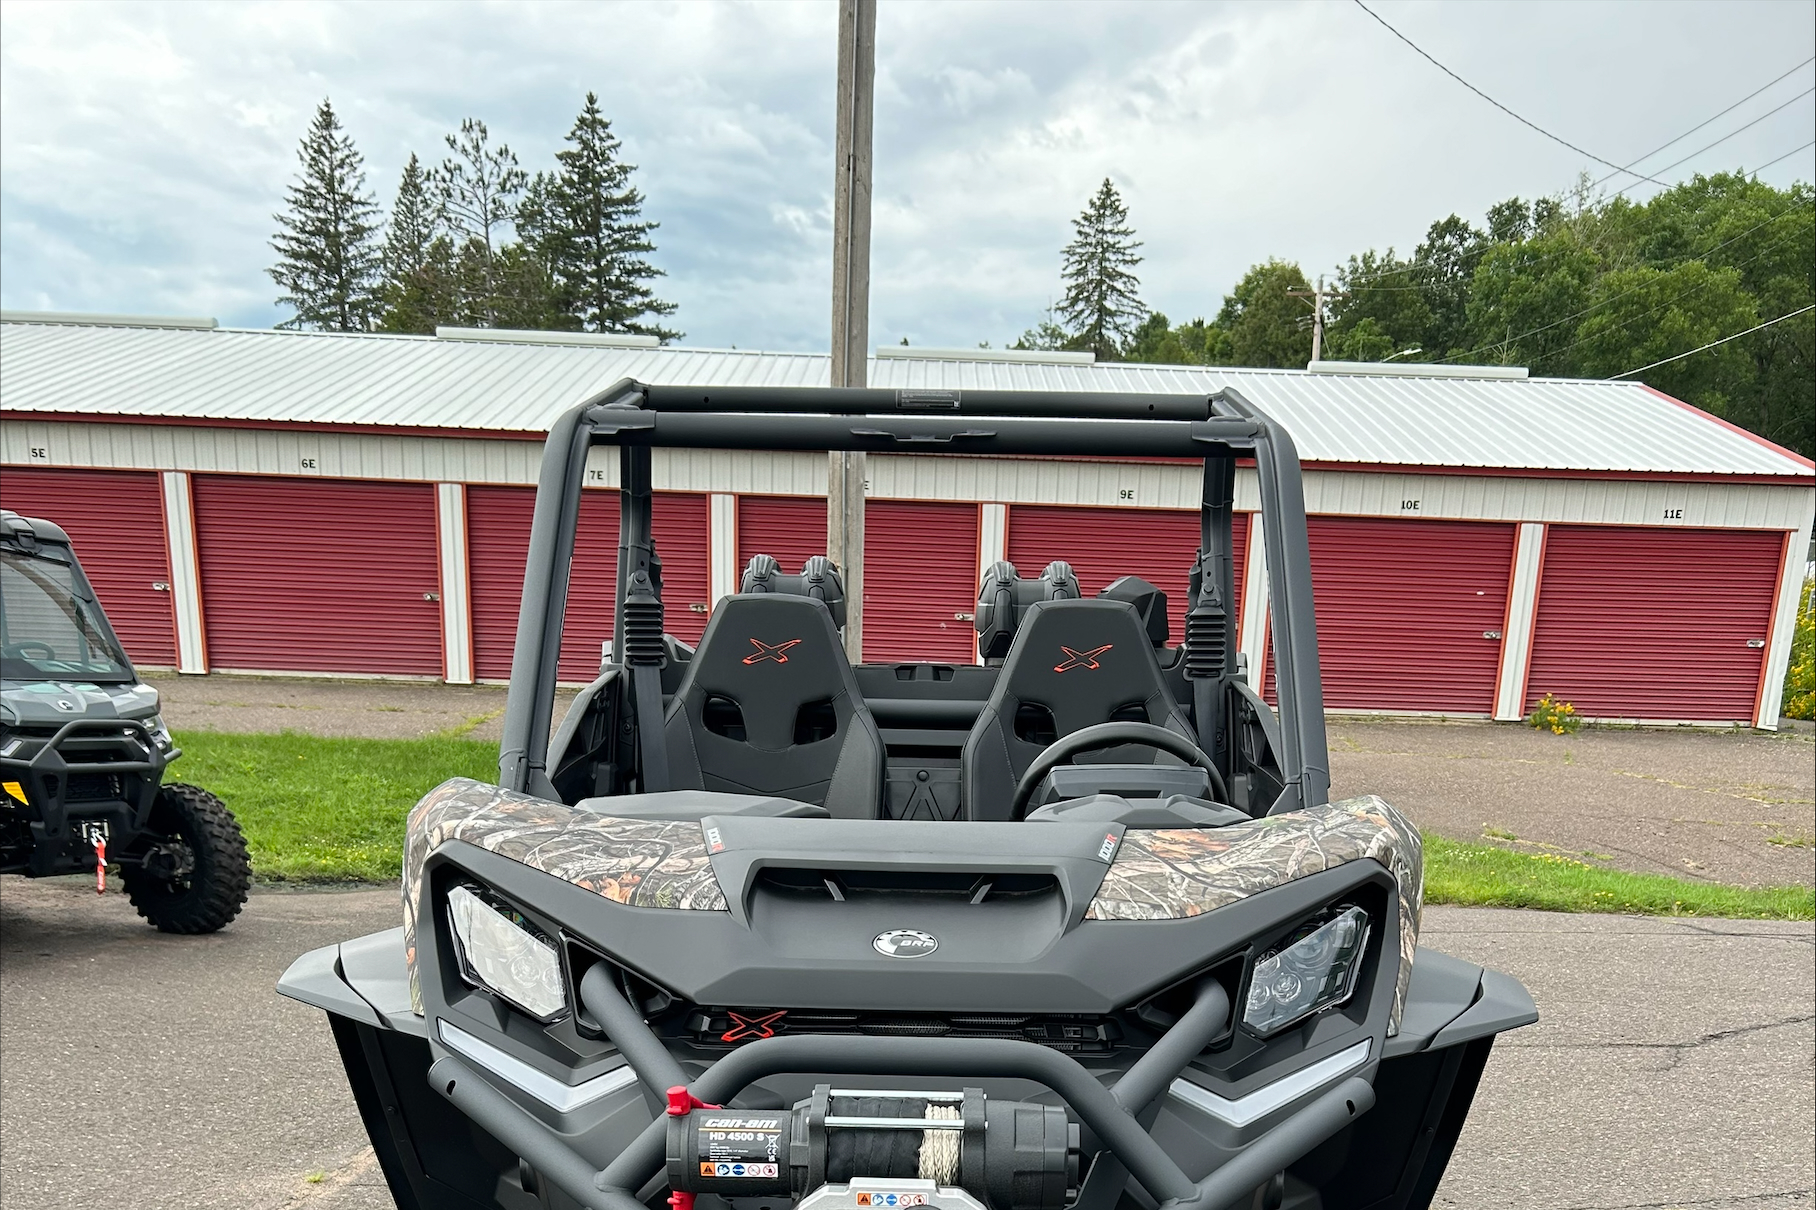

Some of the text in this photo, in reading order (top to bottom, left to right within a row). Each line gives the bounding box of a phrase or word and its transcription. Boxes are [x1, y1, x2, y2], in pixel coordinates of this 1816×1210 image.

[31, 448, 46, 458] 5E
[301, 458, 316, 469] 6E
[590, 470, 604, 480] 7E
[1120, 489, 1134, 500] 9E
[1401, 500, 1420, 510] 10E
[1663, 509, 1682, 519] 11E
[707, 827, 724, 853] 1000R
[1098, 833, 1118, 862] 1000R
[705, 1118, 778, 1129] can-am
[709, 1132, 765, 1142] HD 4500 S
